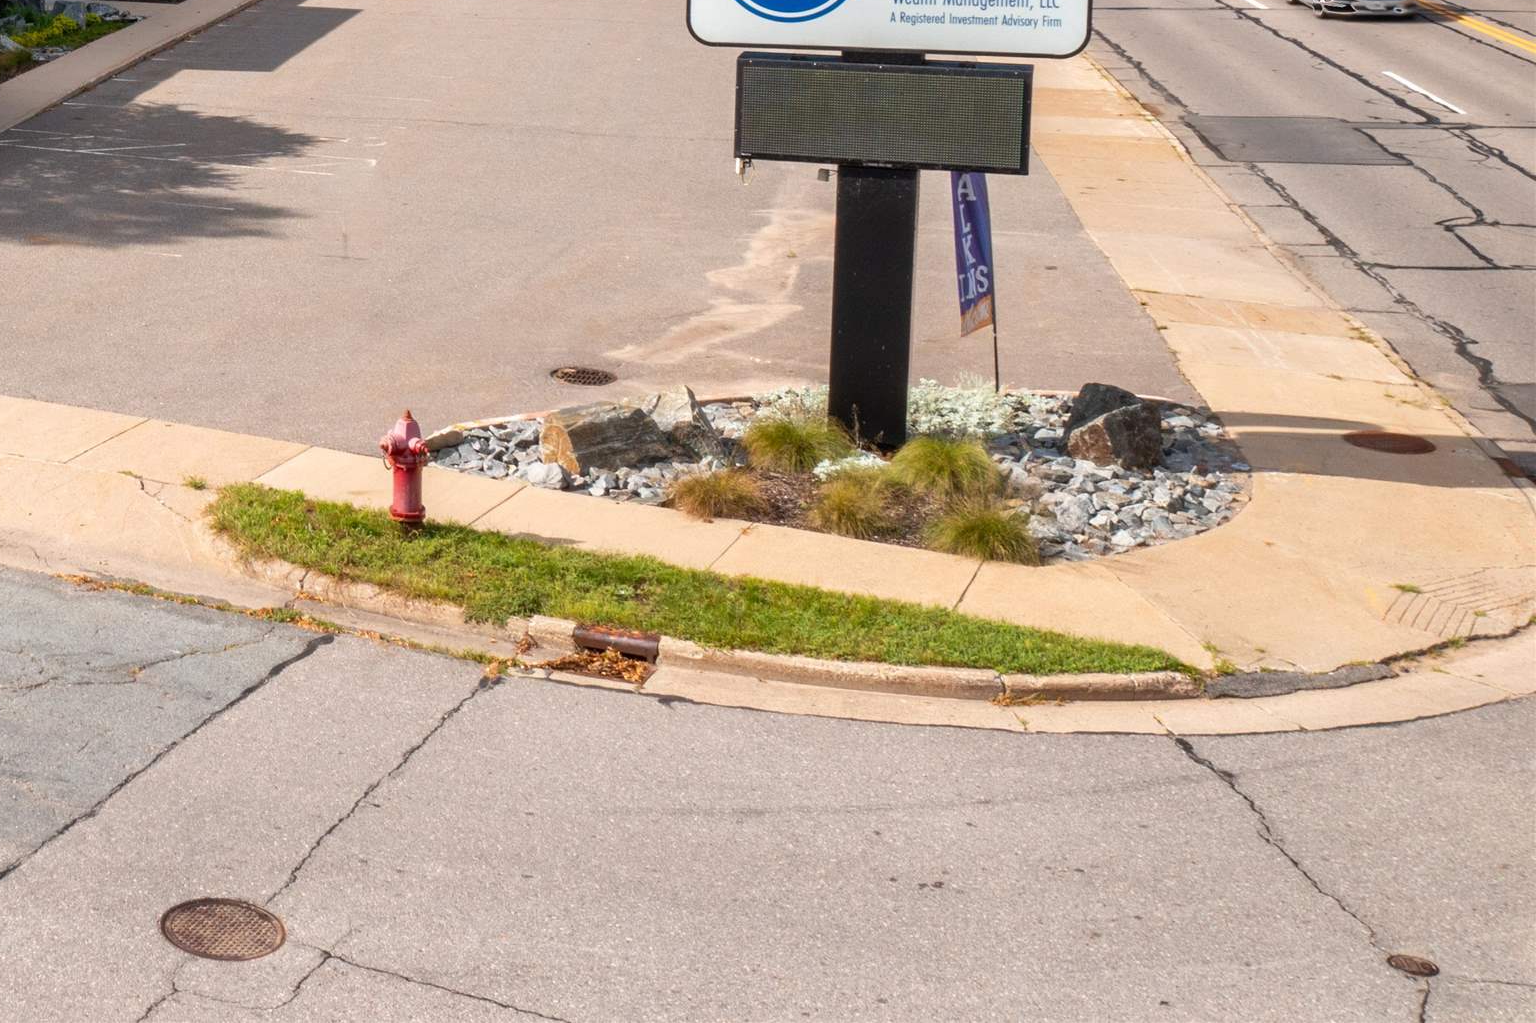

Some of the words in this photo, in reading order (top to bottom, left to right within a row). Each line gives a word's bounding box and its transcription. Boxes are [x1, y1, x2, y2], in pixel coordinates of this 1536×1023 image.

[890, 12, 896, 23] A
[900, 12, 945, 26] Registered
[949, 13, 998, 26] Investment
[1001, 14, 1038, 29] Advisory
[1042, 15, 1062, 27] Firm
